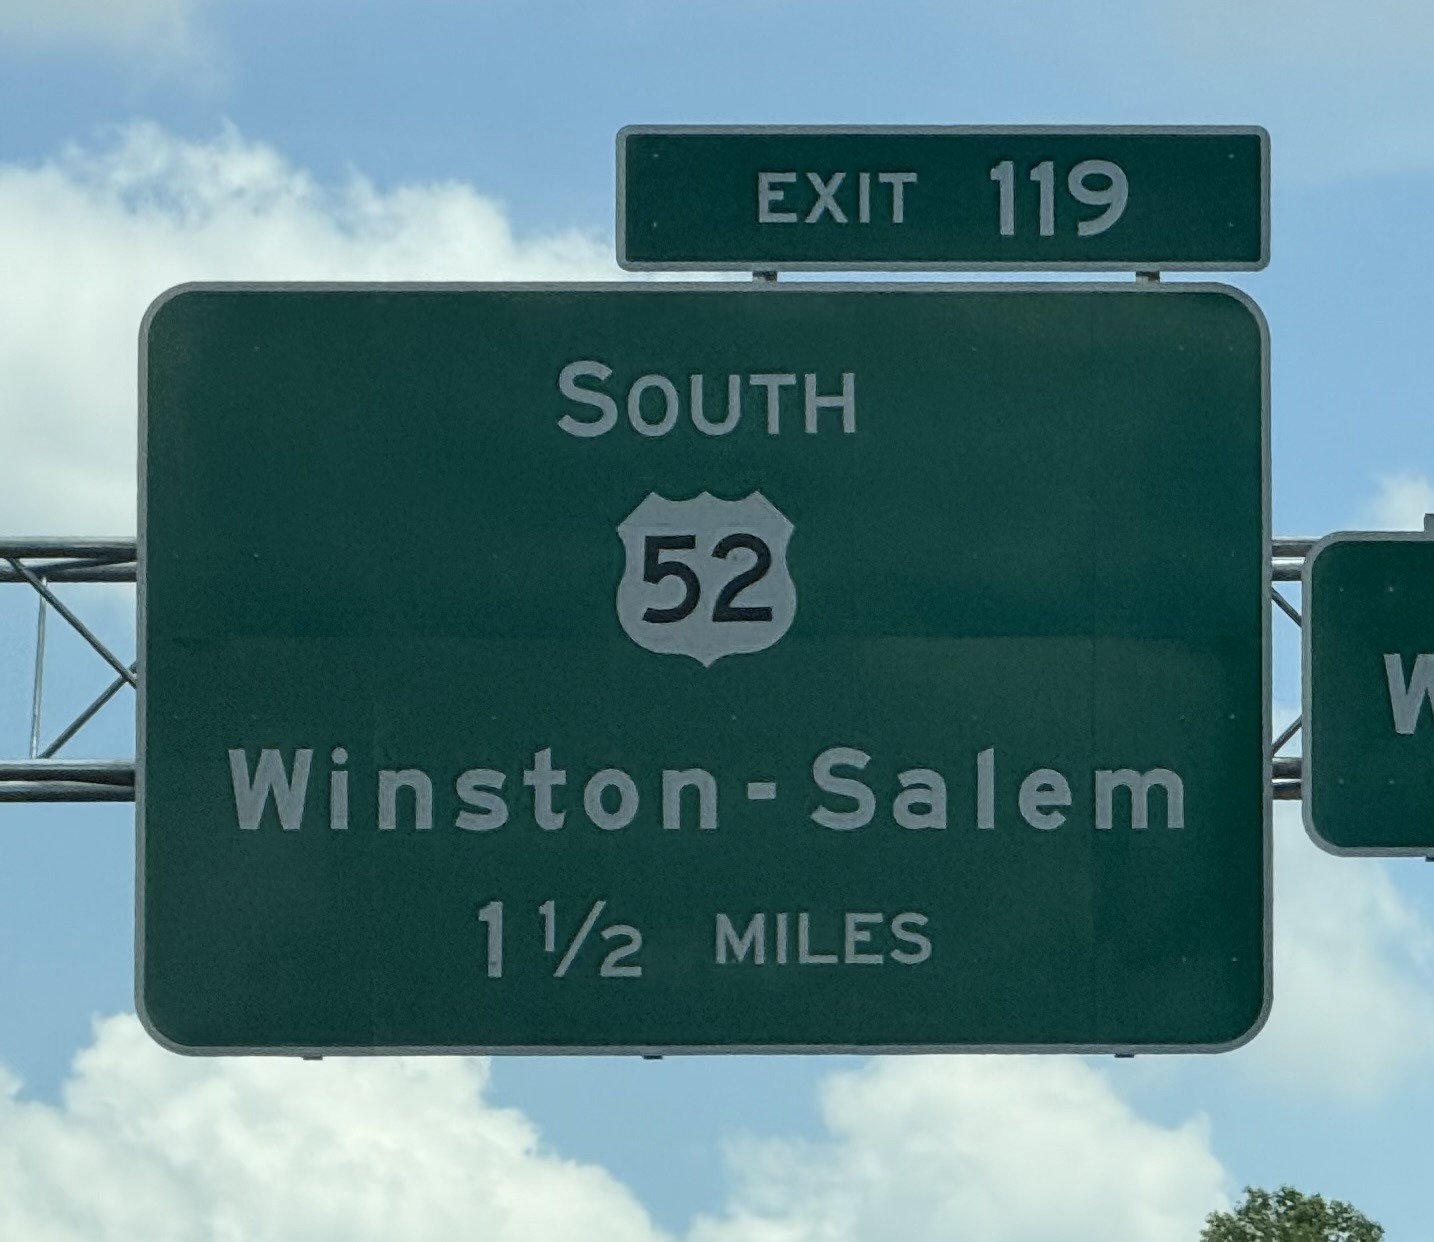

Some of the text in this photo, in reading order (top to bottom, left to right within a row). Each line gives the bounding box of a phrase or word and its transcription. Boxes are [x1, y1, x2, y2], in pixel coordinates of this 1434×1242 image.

[758, 159, 1130, 237] EXIT 119
[557, 360, 857, 438] SOUTH
[642, 532, 772, 624] 52
[227, 746, 1186, 832] Winston-Salem
[715, 911, 933, 966] MILES
